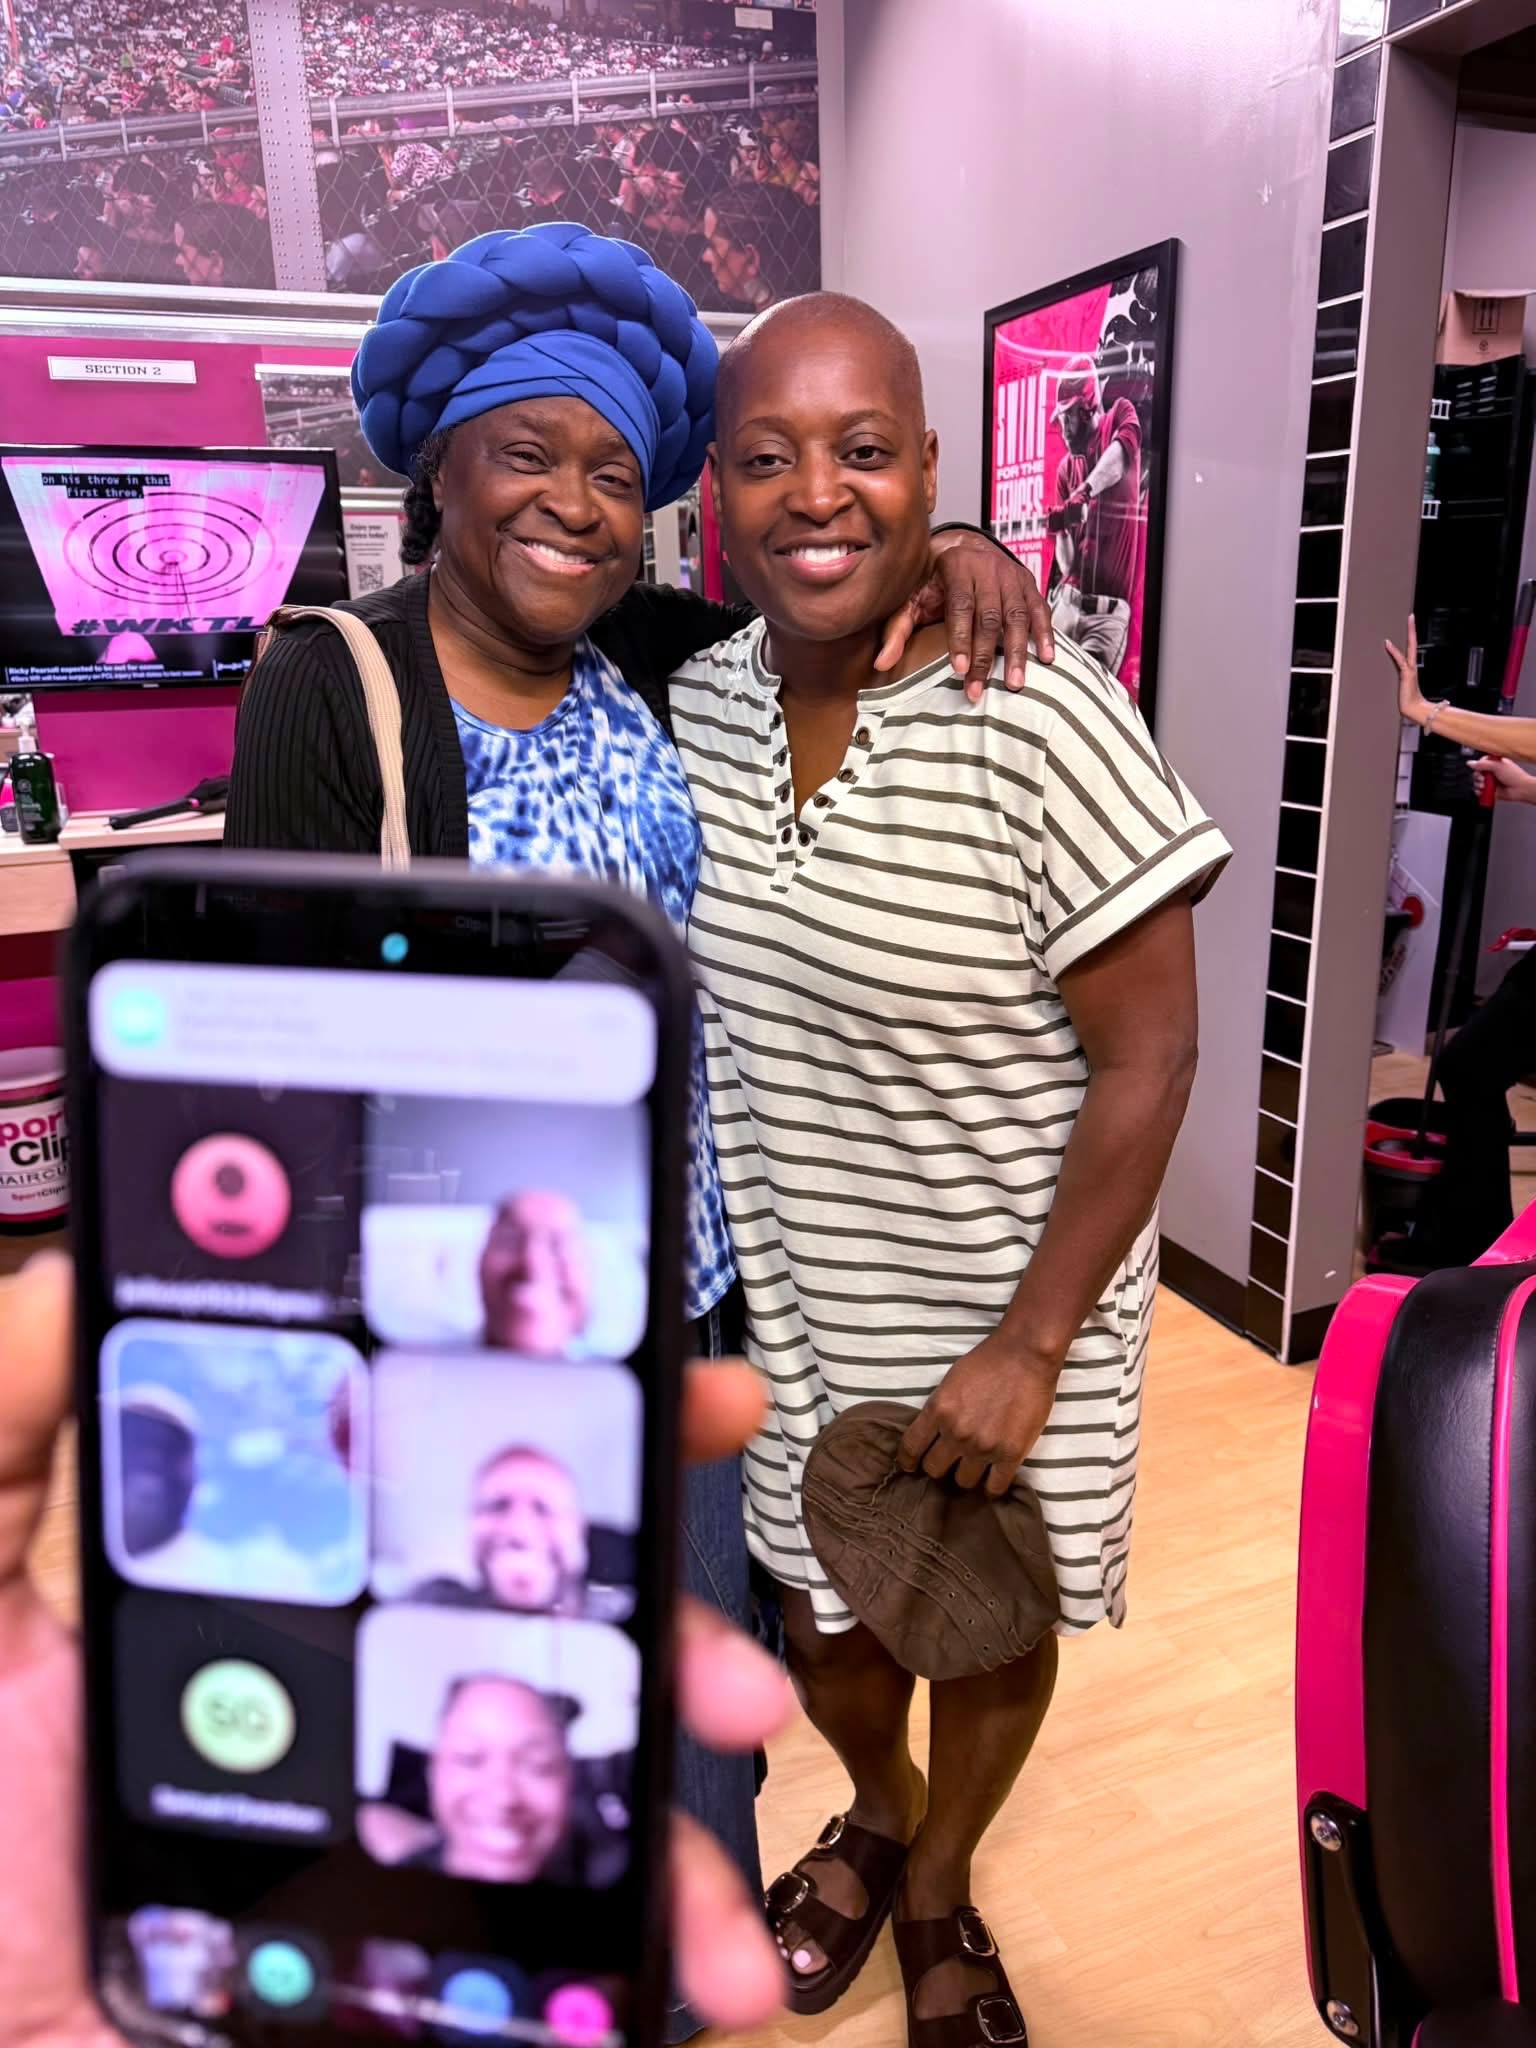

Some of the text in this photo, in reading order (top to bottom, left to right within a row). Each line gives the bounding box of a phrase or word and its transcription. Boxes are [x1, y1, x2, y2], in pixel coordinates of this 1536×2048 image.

[84, 364, 162, 376] SECTION 2
[996, 460, 1044, 480] FOR THE
[42, 475, 170, 485] on his throw in that
[67, 487, 98, 497] first
[0, 1111, 65, 1148] por
[0, 1164, 67, 1185] AIRCU
